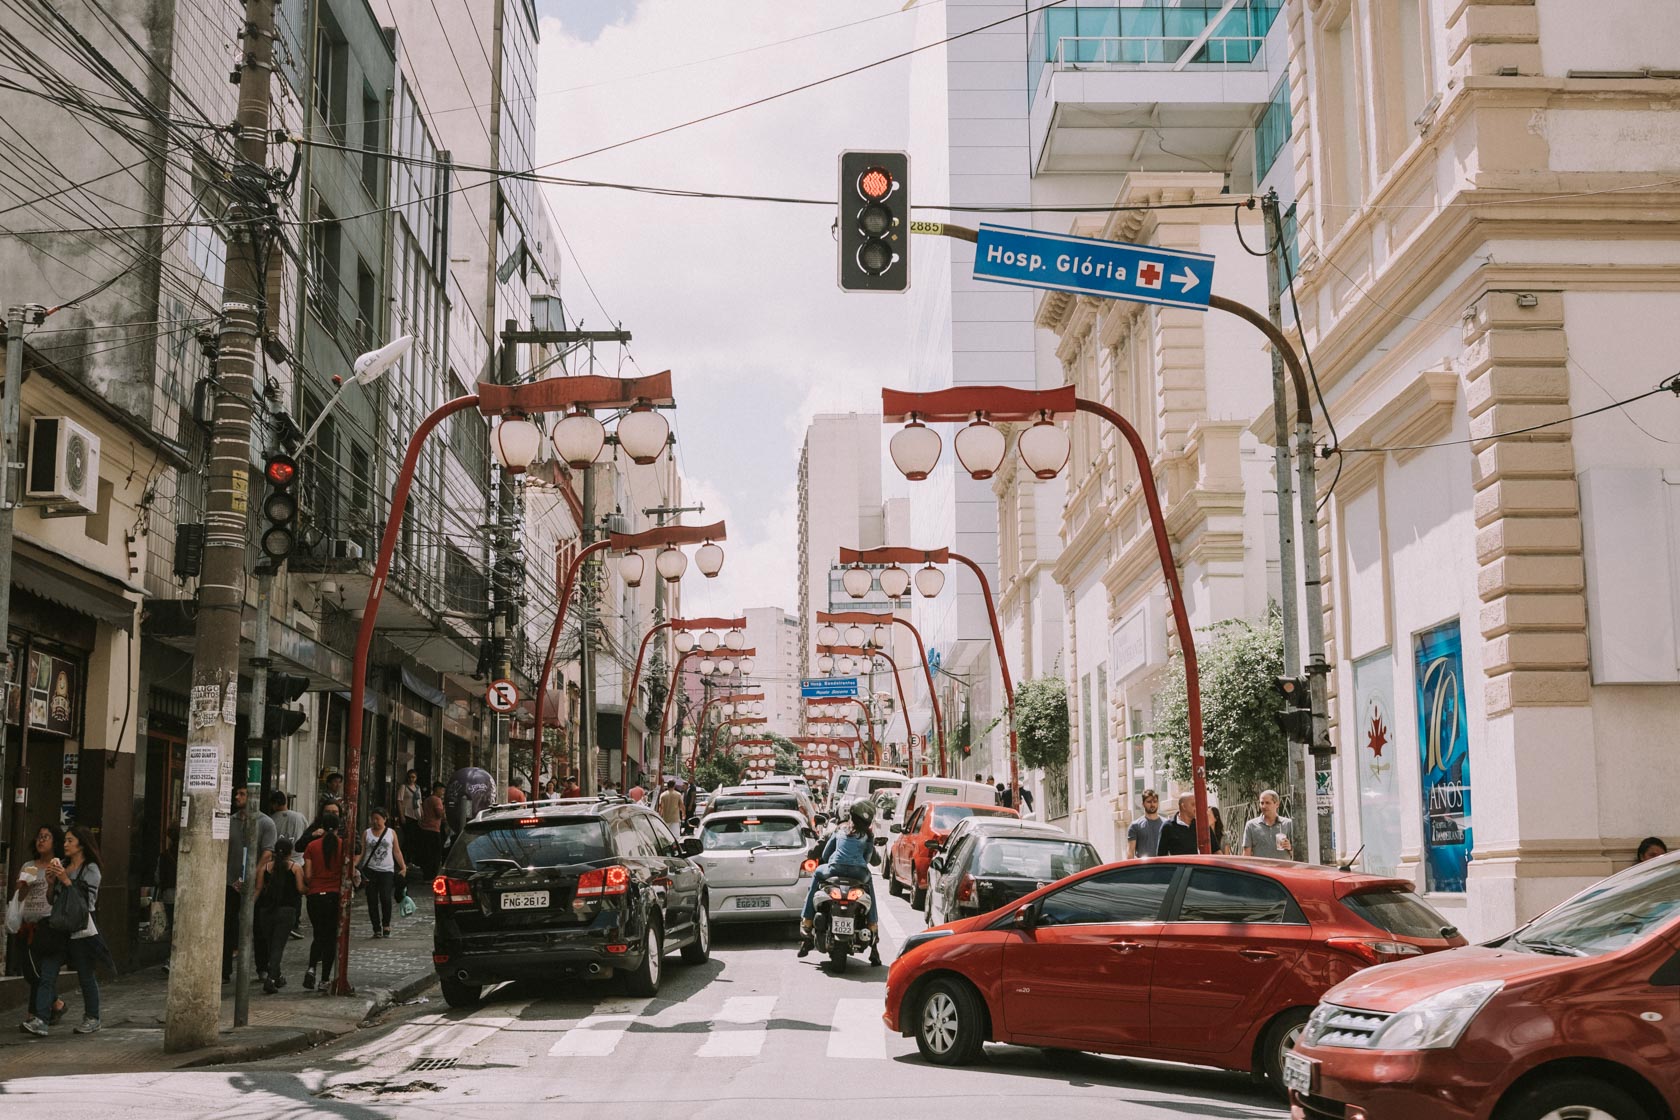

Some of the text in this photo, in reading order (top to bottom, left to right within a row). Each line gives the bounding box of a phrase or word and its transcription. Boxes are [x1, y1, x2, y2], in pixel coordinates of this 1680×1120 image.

[910, 221, 940, 232] 2885
[986, 244, 1127, 281] Hosp. Glória
[497, 687, 508, 705] E
[1430, 780, 1463, 810] ANOS
[503, 896, 547, 907] FNG-2612
